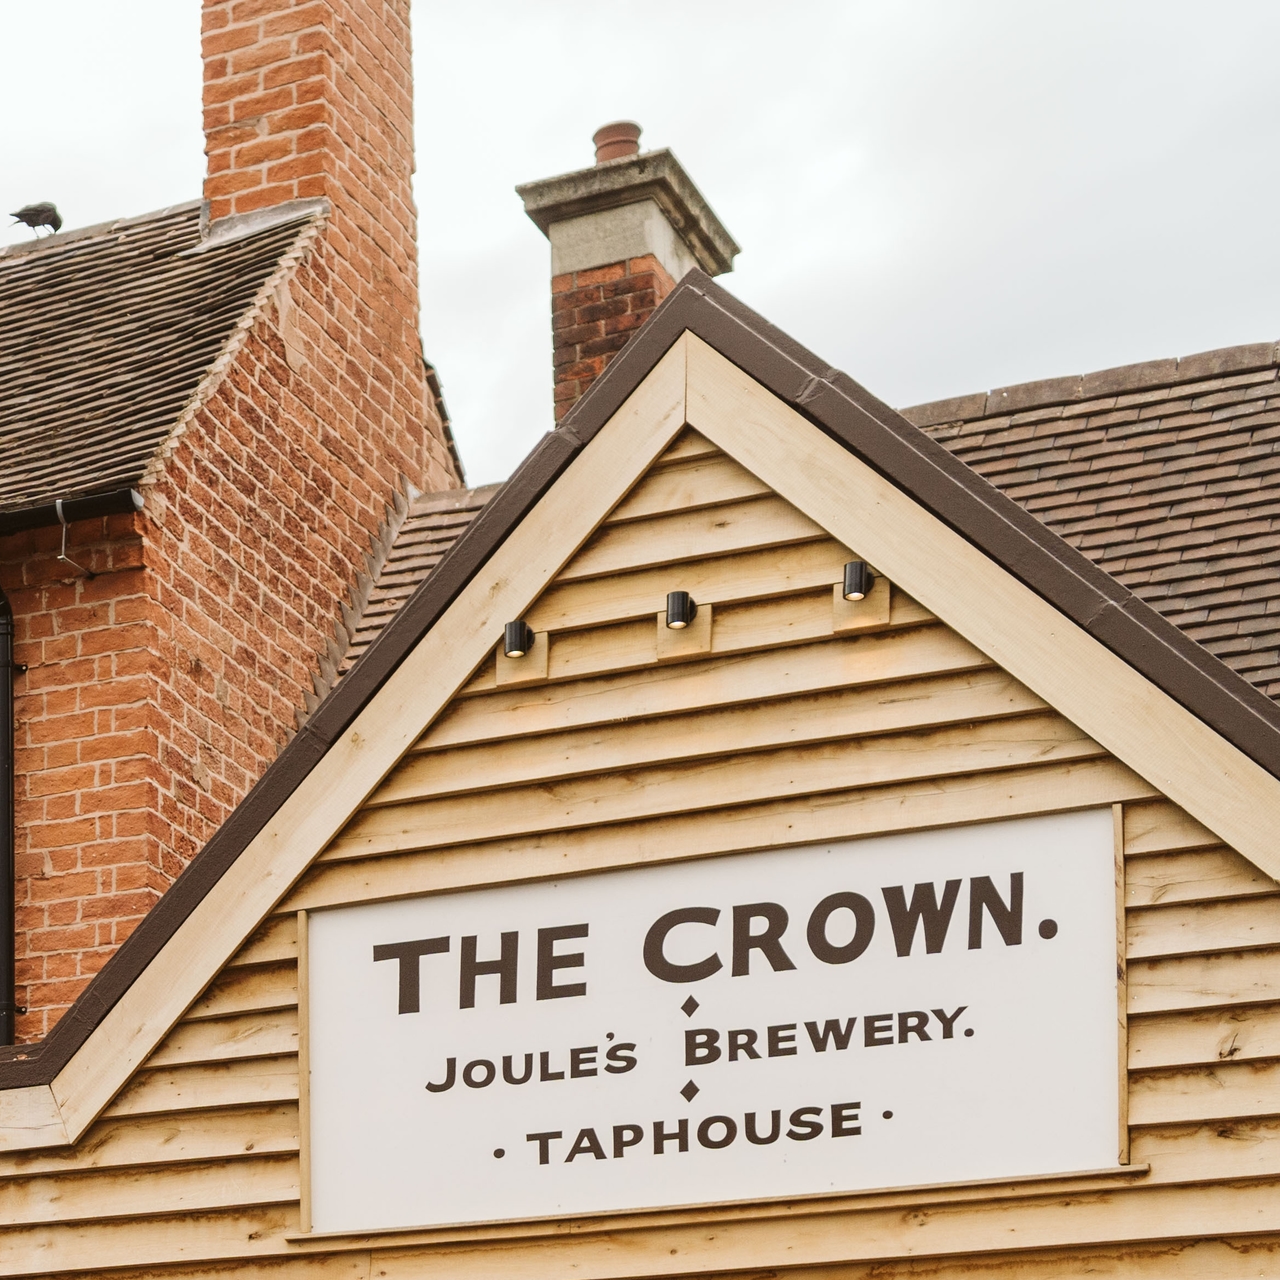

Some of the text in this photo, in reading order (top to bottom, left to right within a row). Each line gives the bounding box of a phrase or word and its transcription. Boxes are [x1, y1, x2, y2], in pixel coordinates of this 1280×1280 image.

[372, 871, 1059, 1016] THE CROWN.
[424, 1005, 975, 1094] JOULE'S BREWERY.
[525, 1101, 862, 1166] TAPHOUSE
